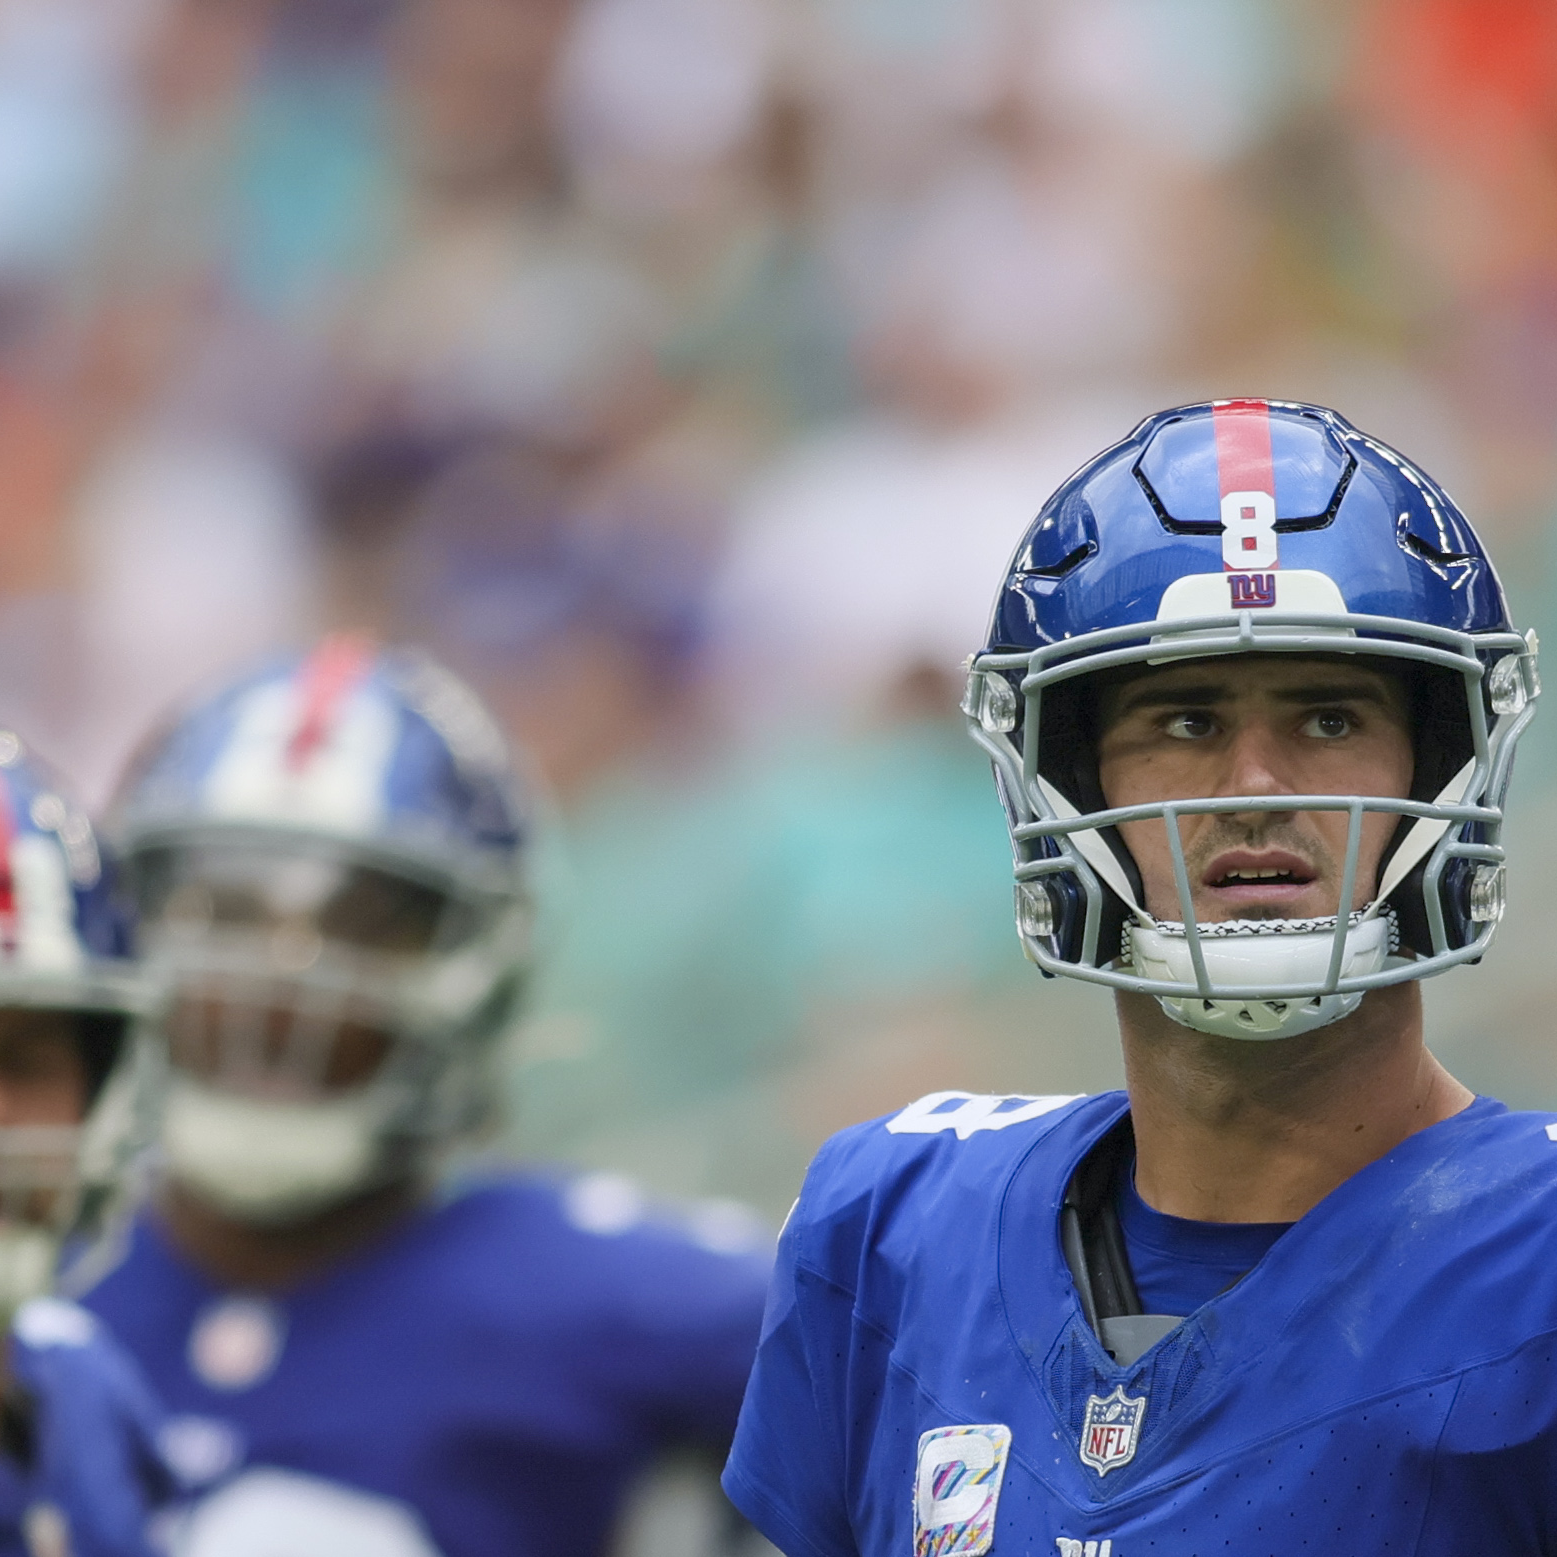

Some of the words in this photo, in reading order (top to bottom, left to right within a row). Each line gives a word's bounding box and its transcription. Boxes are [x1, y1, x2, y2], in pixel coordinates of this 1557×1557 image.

[1218, 490, 1279, 569] 8
[918, 1432, 994, 1530] C
[1088, 1426, 1127, 1459] NFL
